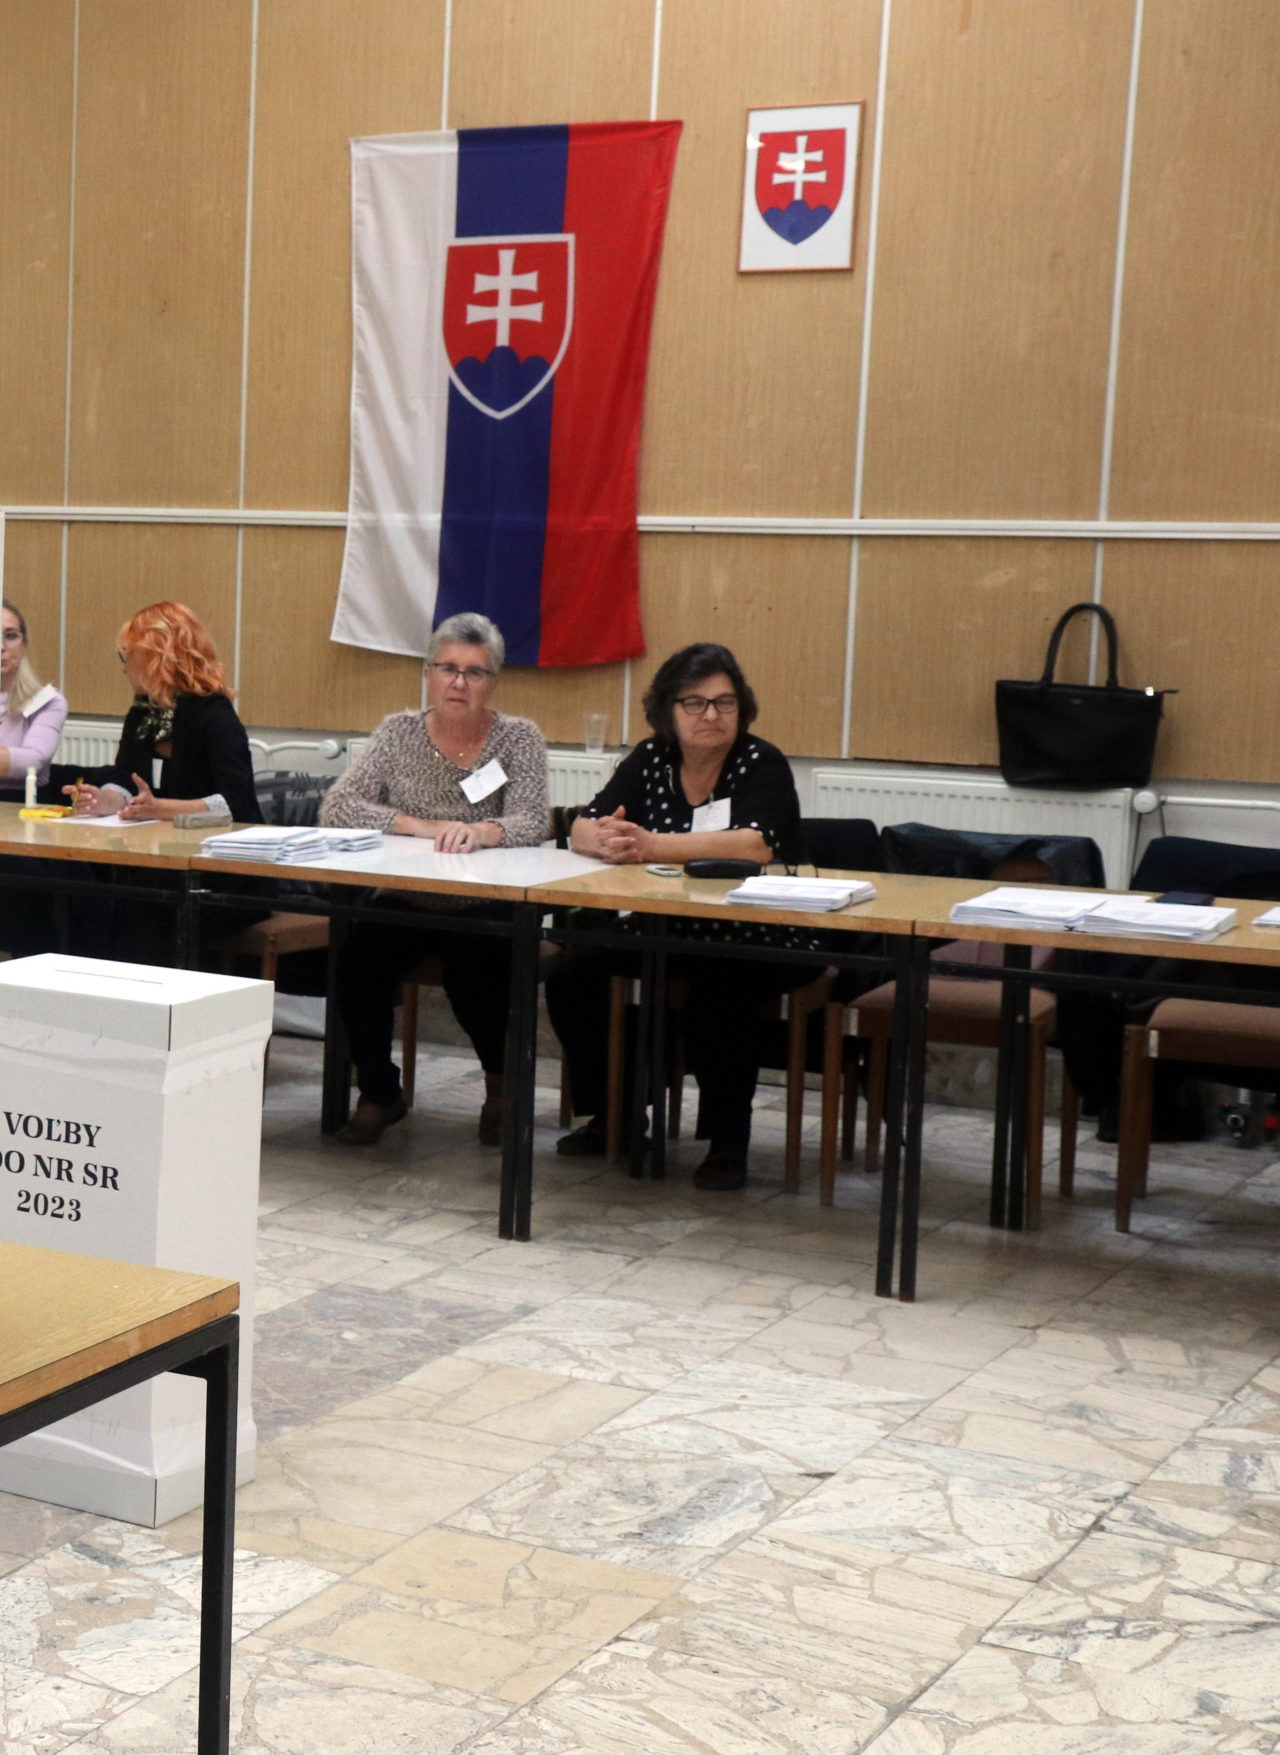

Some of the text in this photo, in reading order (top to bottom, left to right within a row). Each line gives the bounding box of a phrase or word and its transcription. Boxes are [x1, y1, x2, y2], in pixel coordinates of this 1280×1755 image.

[3, 1111, 102, 1148] VOĽBY
[32, 1154, 75, 1183] NR
[82, 1162, 120, 1191] SR
[16, 1189, 81, 1222] 2023
